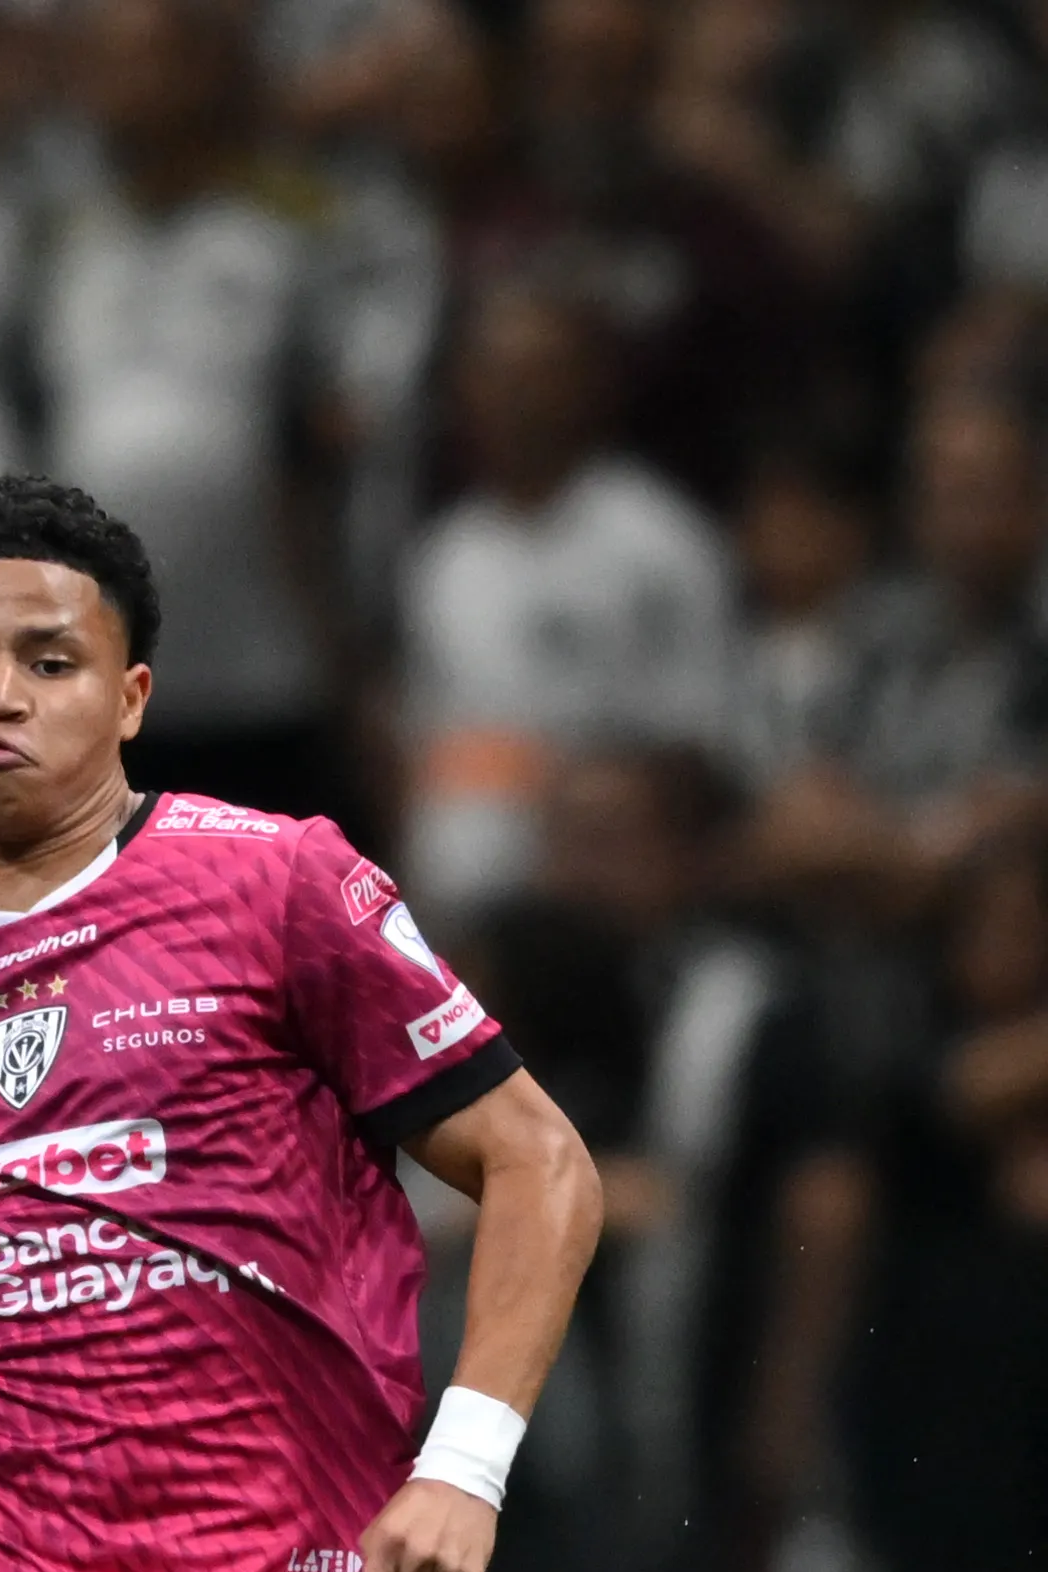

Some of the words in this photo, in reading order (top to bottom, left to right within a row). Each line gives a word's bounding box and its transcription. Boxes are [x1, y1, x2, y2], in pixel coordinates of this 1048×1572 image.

[156, 813, 199, 830] del
[198, 815, 281, 834] Barrio
[92, 996, 219, 1029] CHUBB
[103, 1028, 206, 1053] SEGUROS
